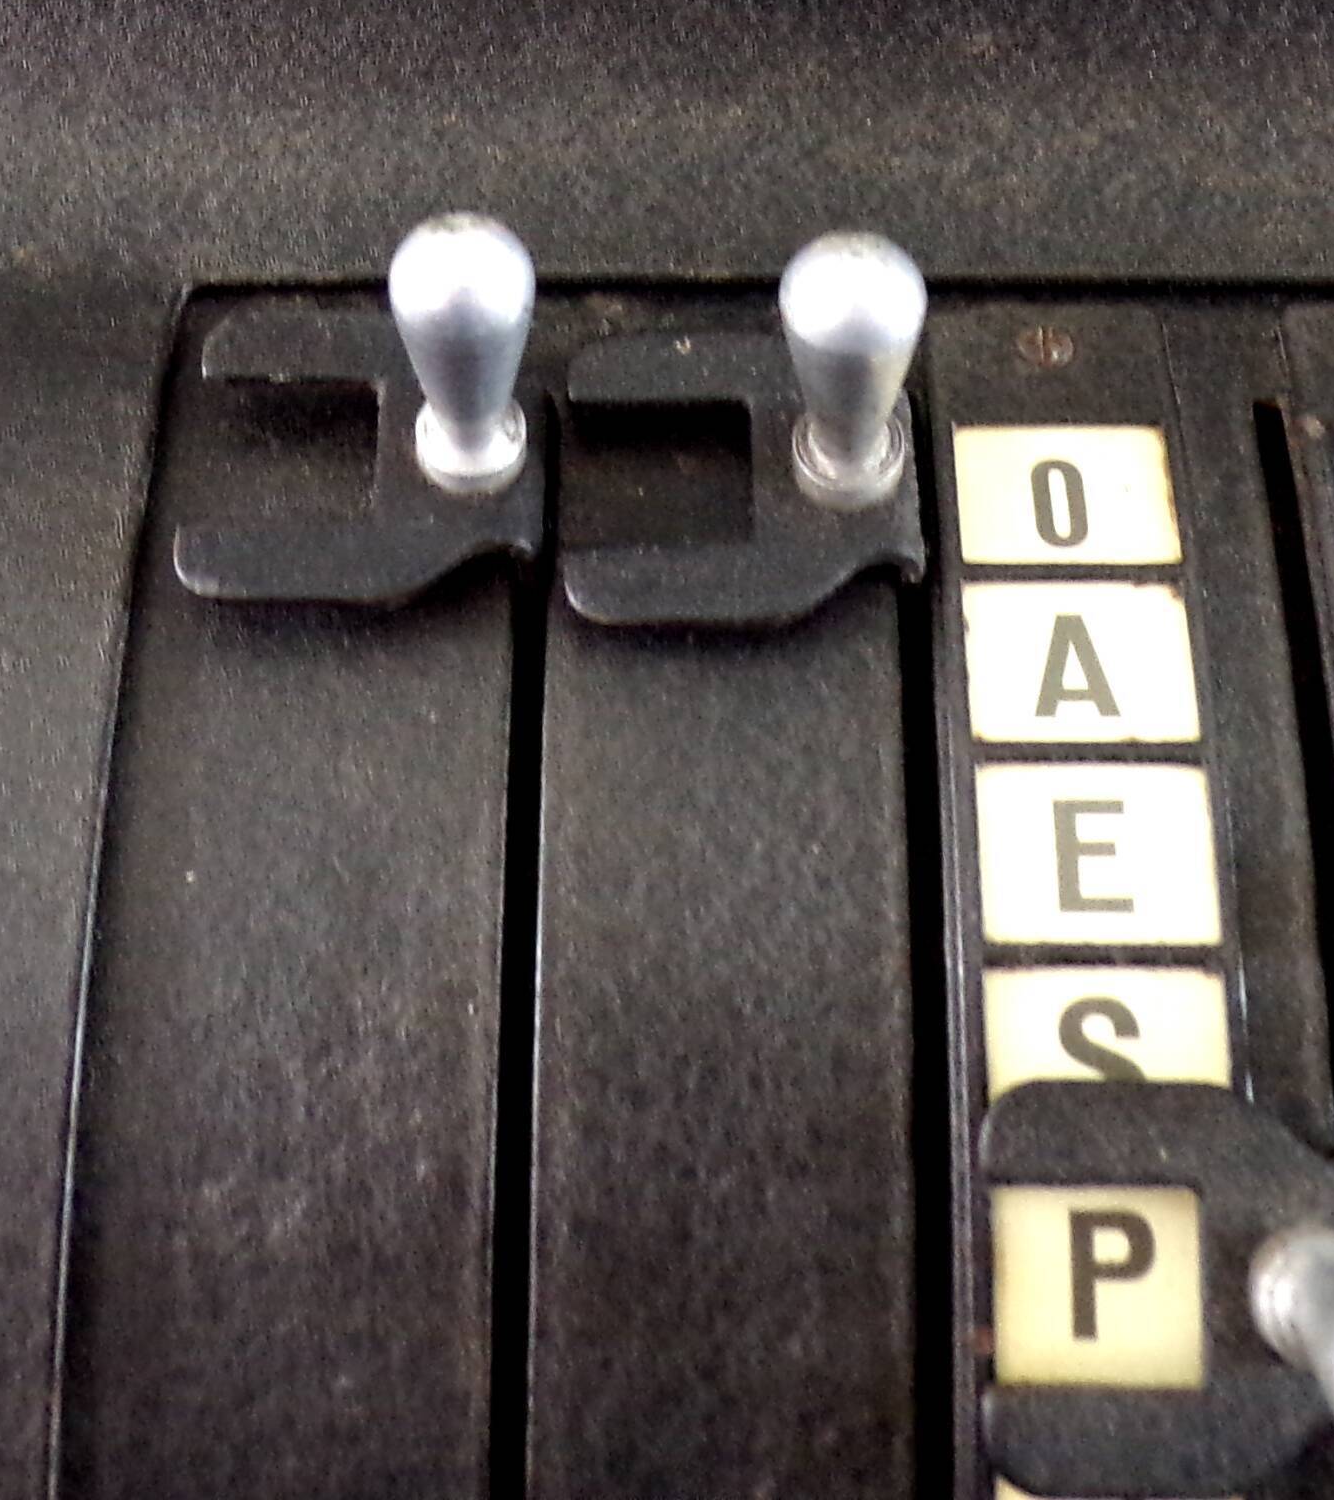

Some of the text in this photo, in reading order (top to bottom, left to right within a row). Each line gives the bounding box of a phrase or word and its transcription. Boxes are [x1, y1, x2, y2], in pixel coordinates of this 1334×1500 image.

[1029, 458, 1090, 548] 0
[1034, 613, 1122, 717] A
[1052, 799, 1135, 914] E
[1067, 1209, 1157, 1341] P
